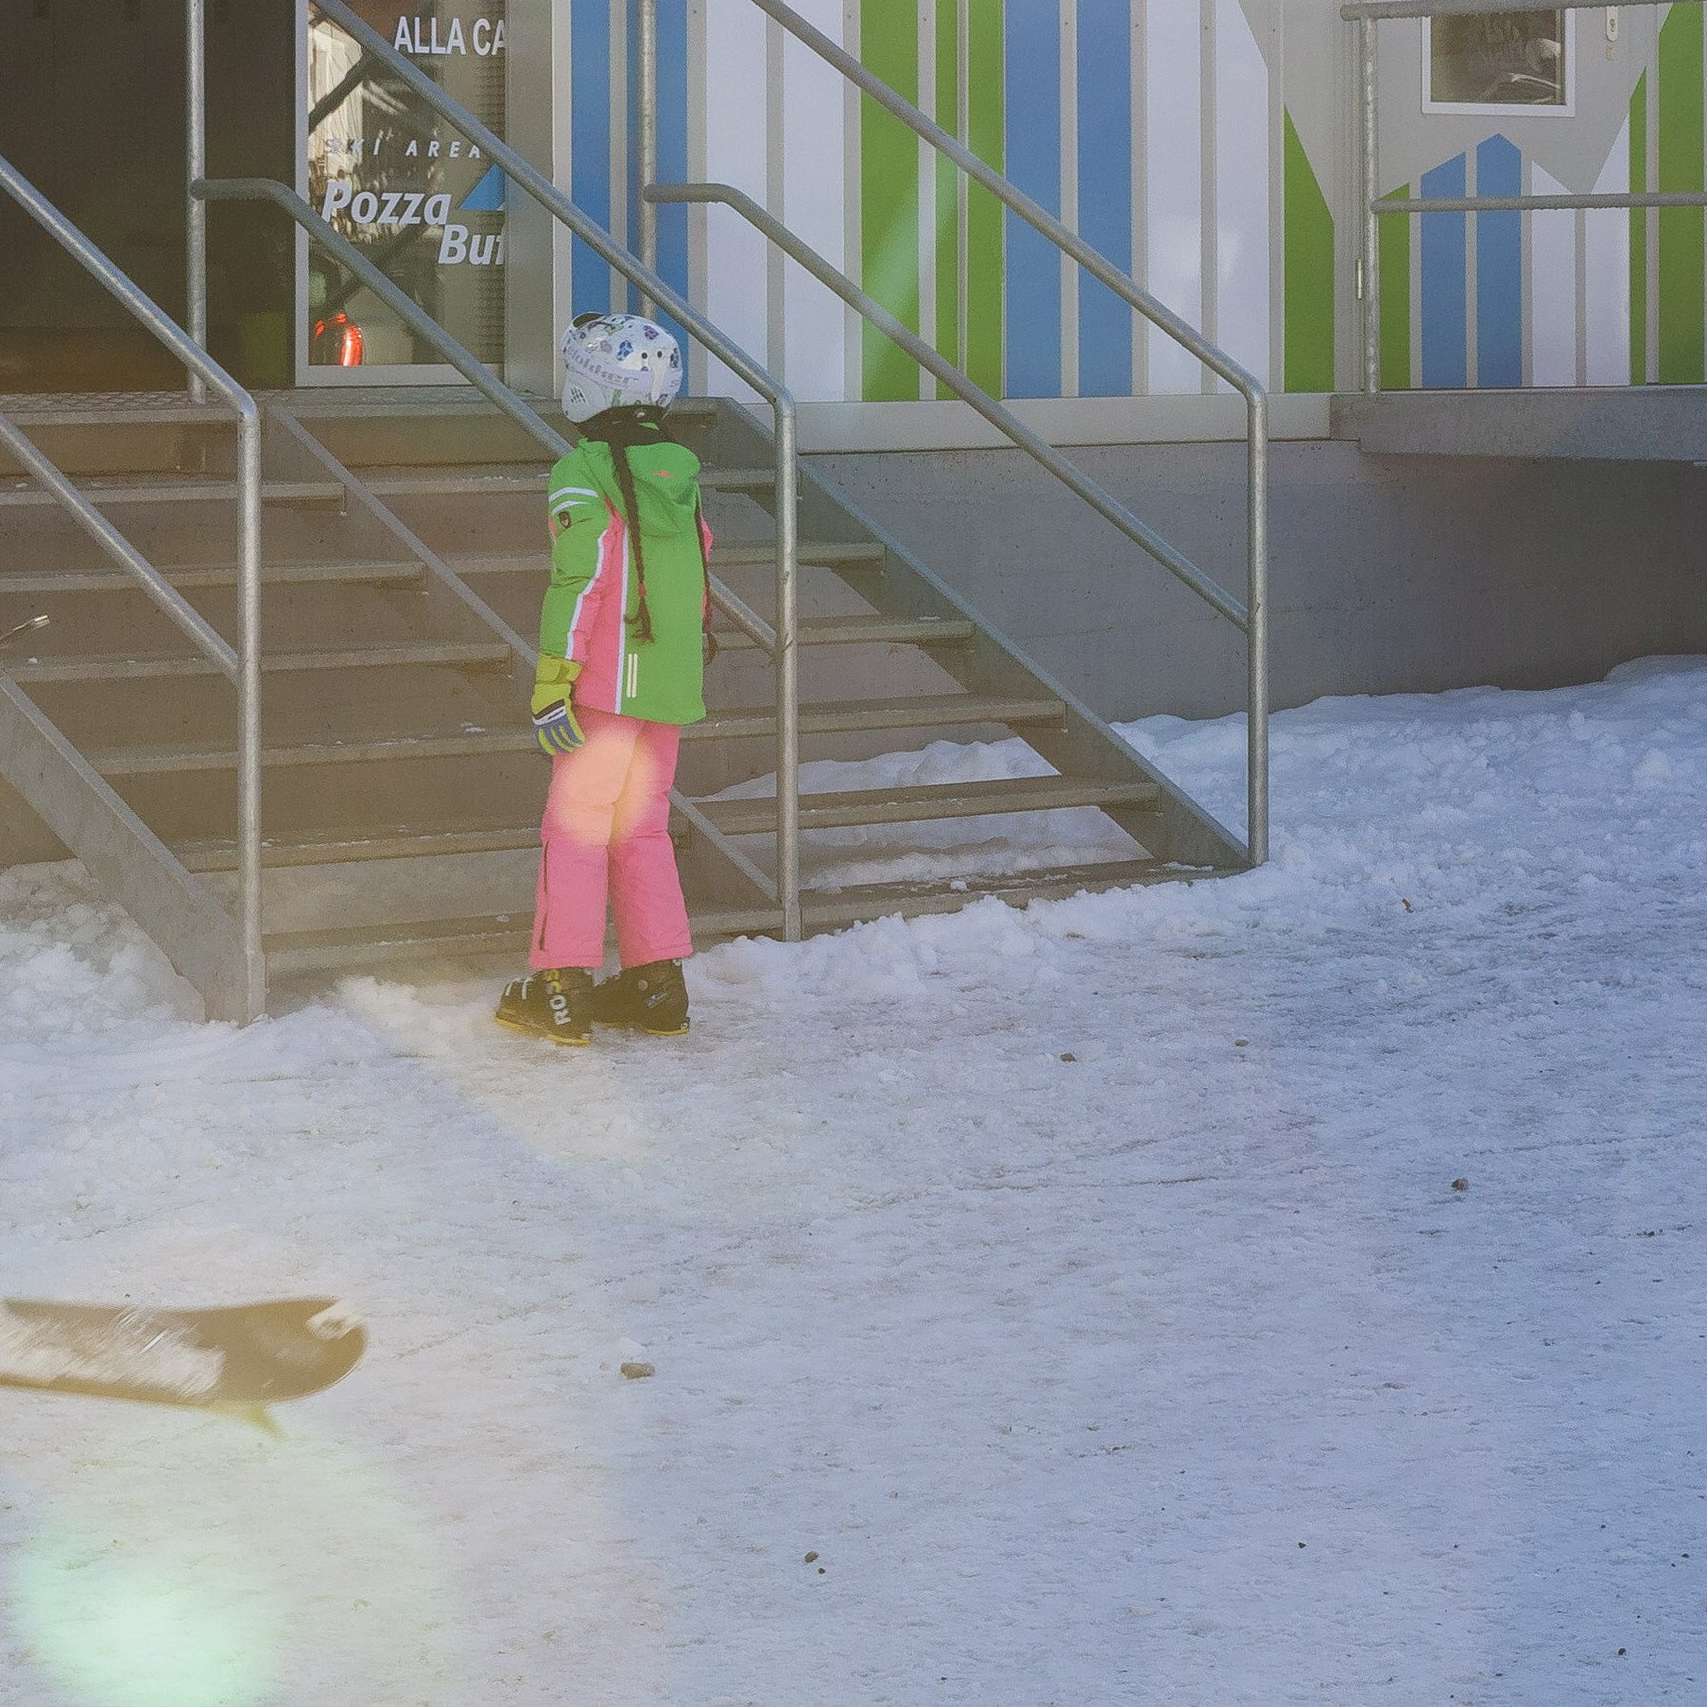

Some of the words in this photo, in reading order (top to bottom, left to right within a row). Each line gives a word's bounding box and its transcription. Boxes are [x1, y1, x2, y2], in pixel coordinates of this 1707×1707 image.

[394, 16, 467, 56] ALLA
[405, 140, 481, 159] AREA
[321, 180, 453, 226] Pozza
